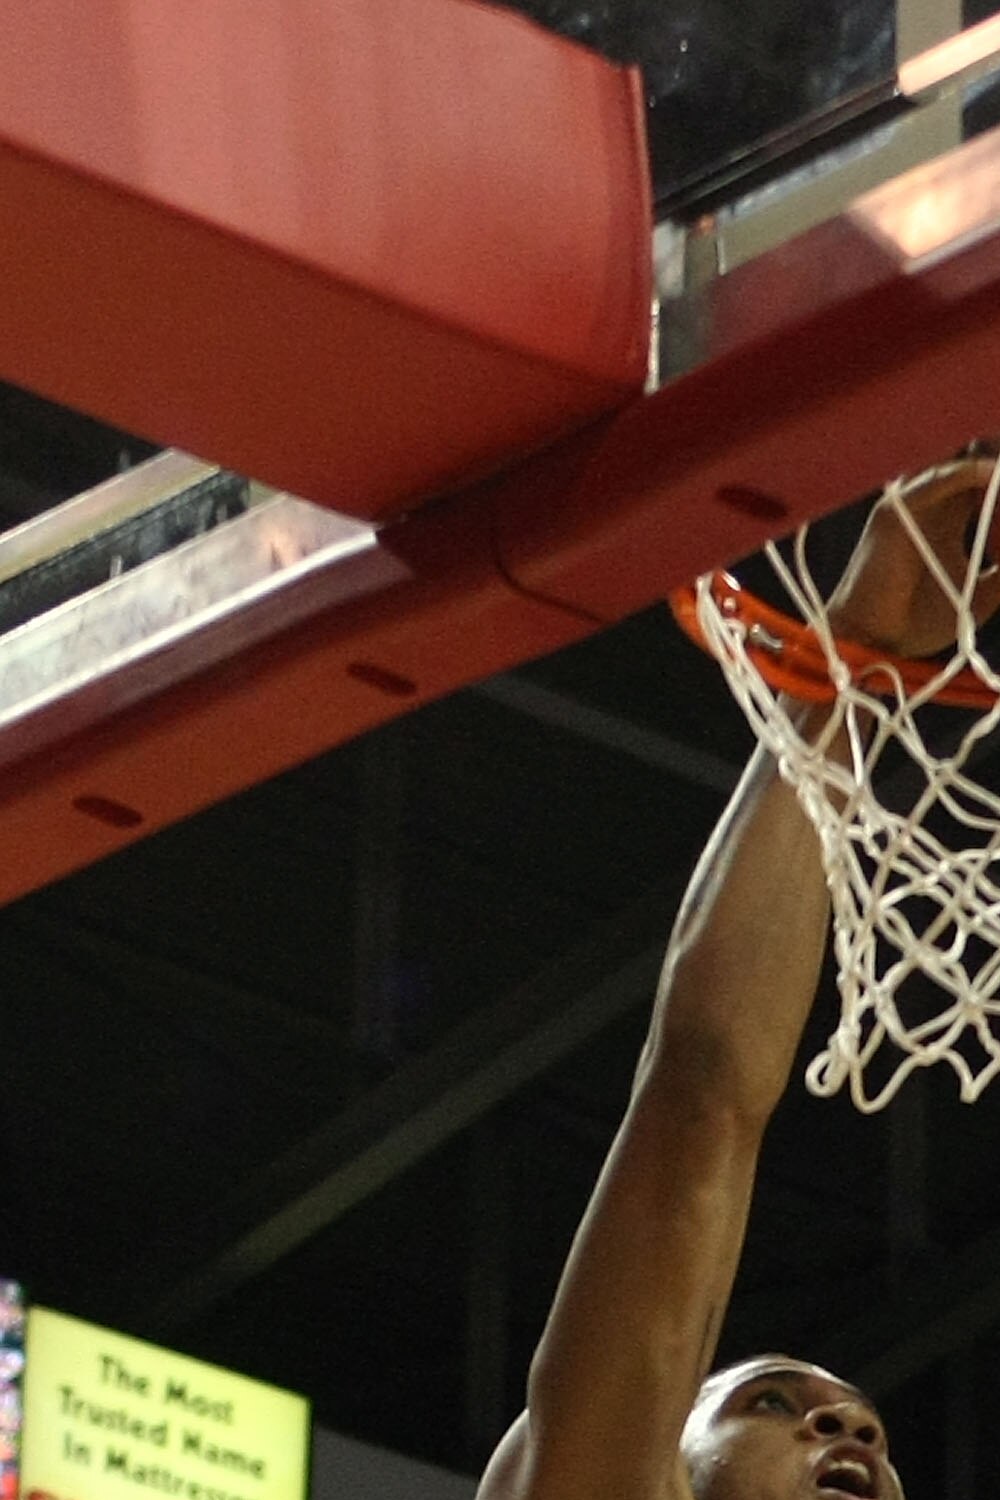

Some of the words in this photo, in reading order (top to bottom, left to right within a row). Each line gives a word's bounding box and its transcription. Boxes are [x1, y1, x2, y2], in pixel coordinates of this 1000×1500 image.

[101, 1353, 149, 1396] The
[165, 1375, 233, 1424] Most
[60, 1385, 168, 1446] Trusted
[183, 1428, 266, 1479] Name
[64, 1432, 91, 1466] In
